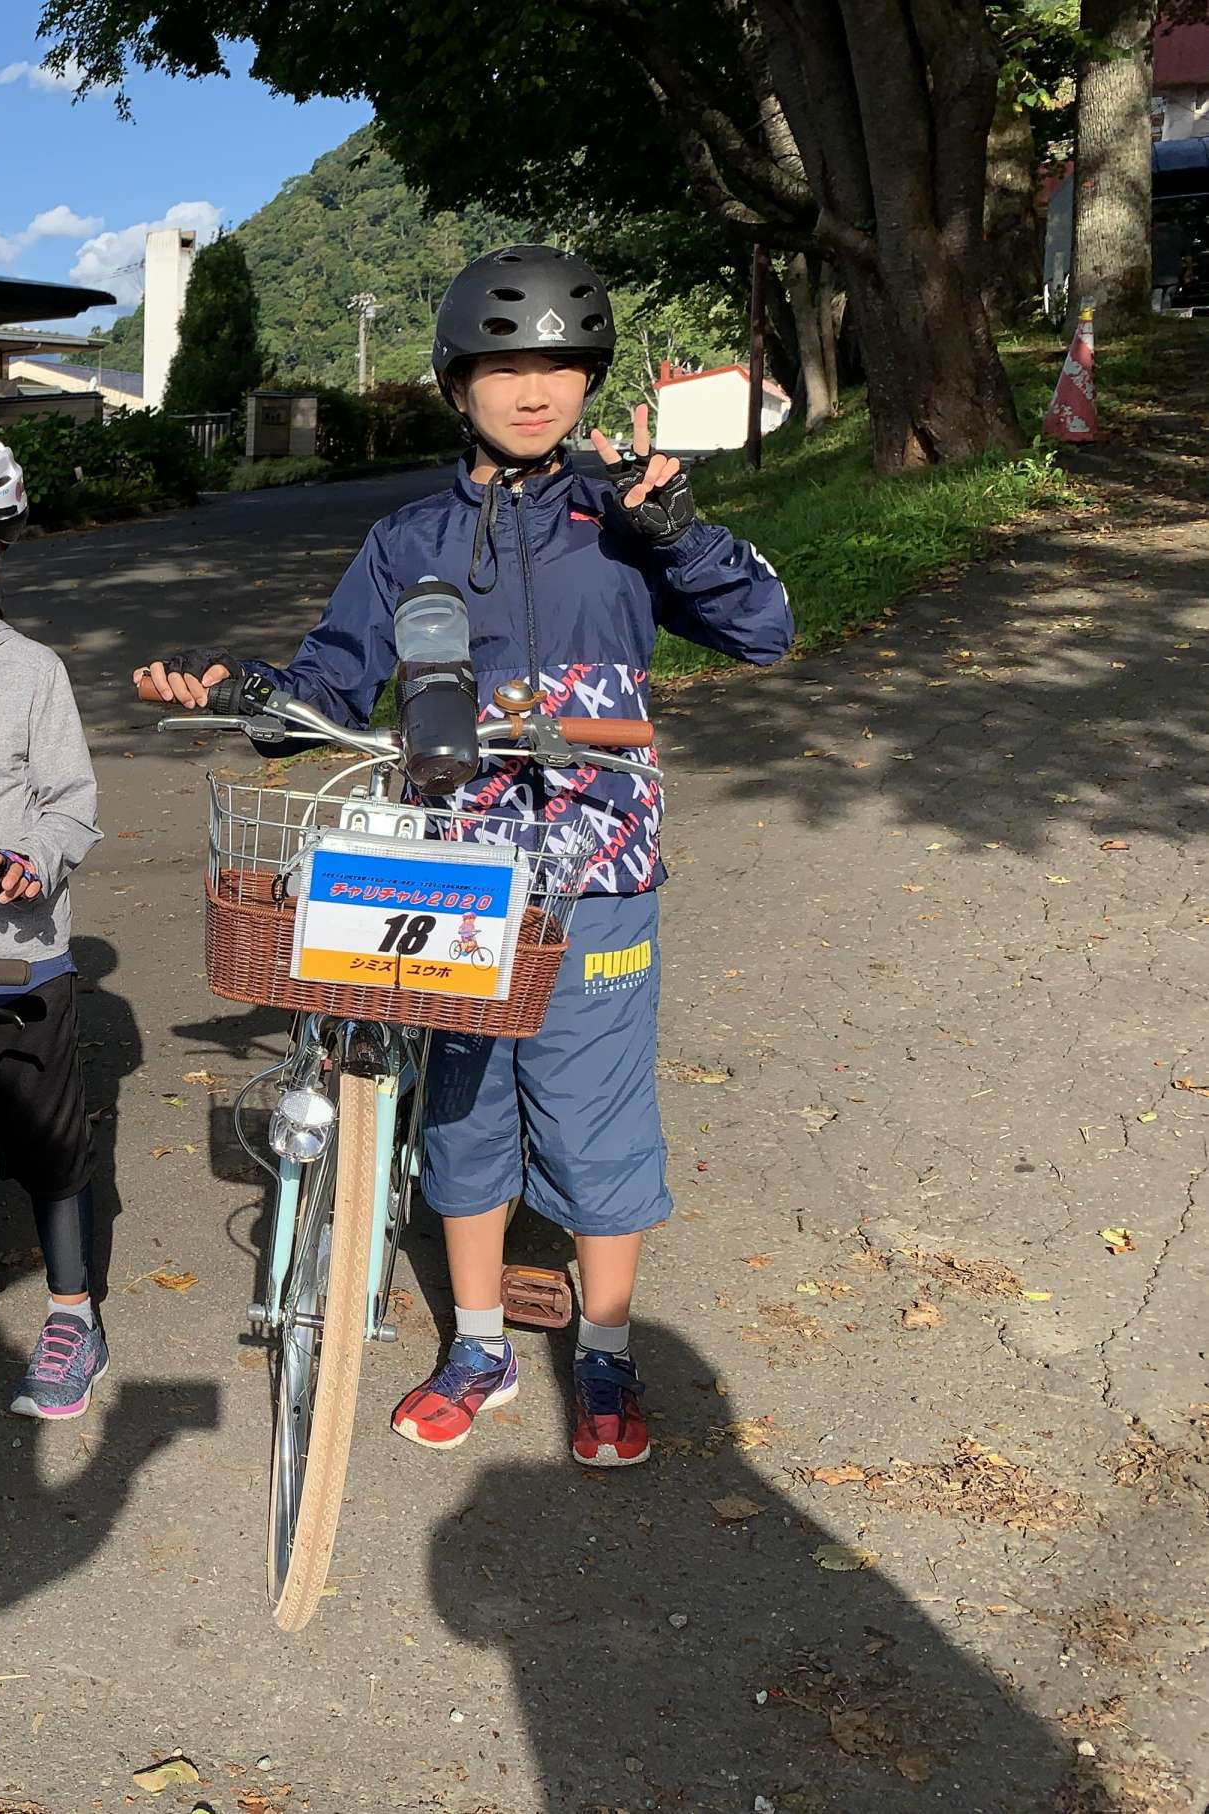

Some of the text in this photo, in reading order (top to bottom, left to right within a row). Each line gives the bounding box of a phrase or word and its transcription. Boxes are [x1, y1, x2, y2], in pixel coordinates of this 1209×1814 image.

[330, 882, 492, 911] チャリチャレ2020
[377, 913, 437, 956] 18
[349, 957, 453, 978] シミズ ユウホ
[584, 939, 651, 980] PUMA
